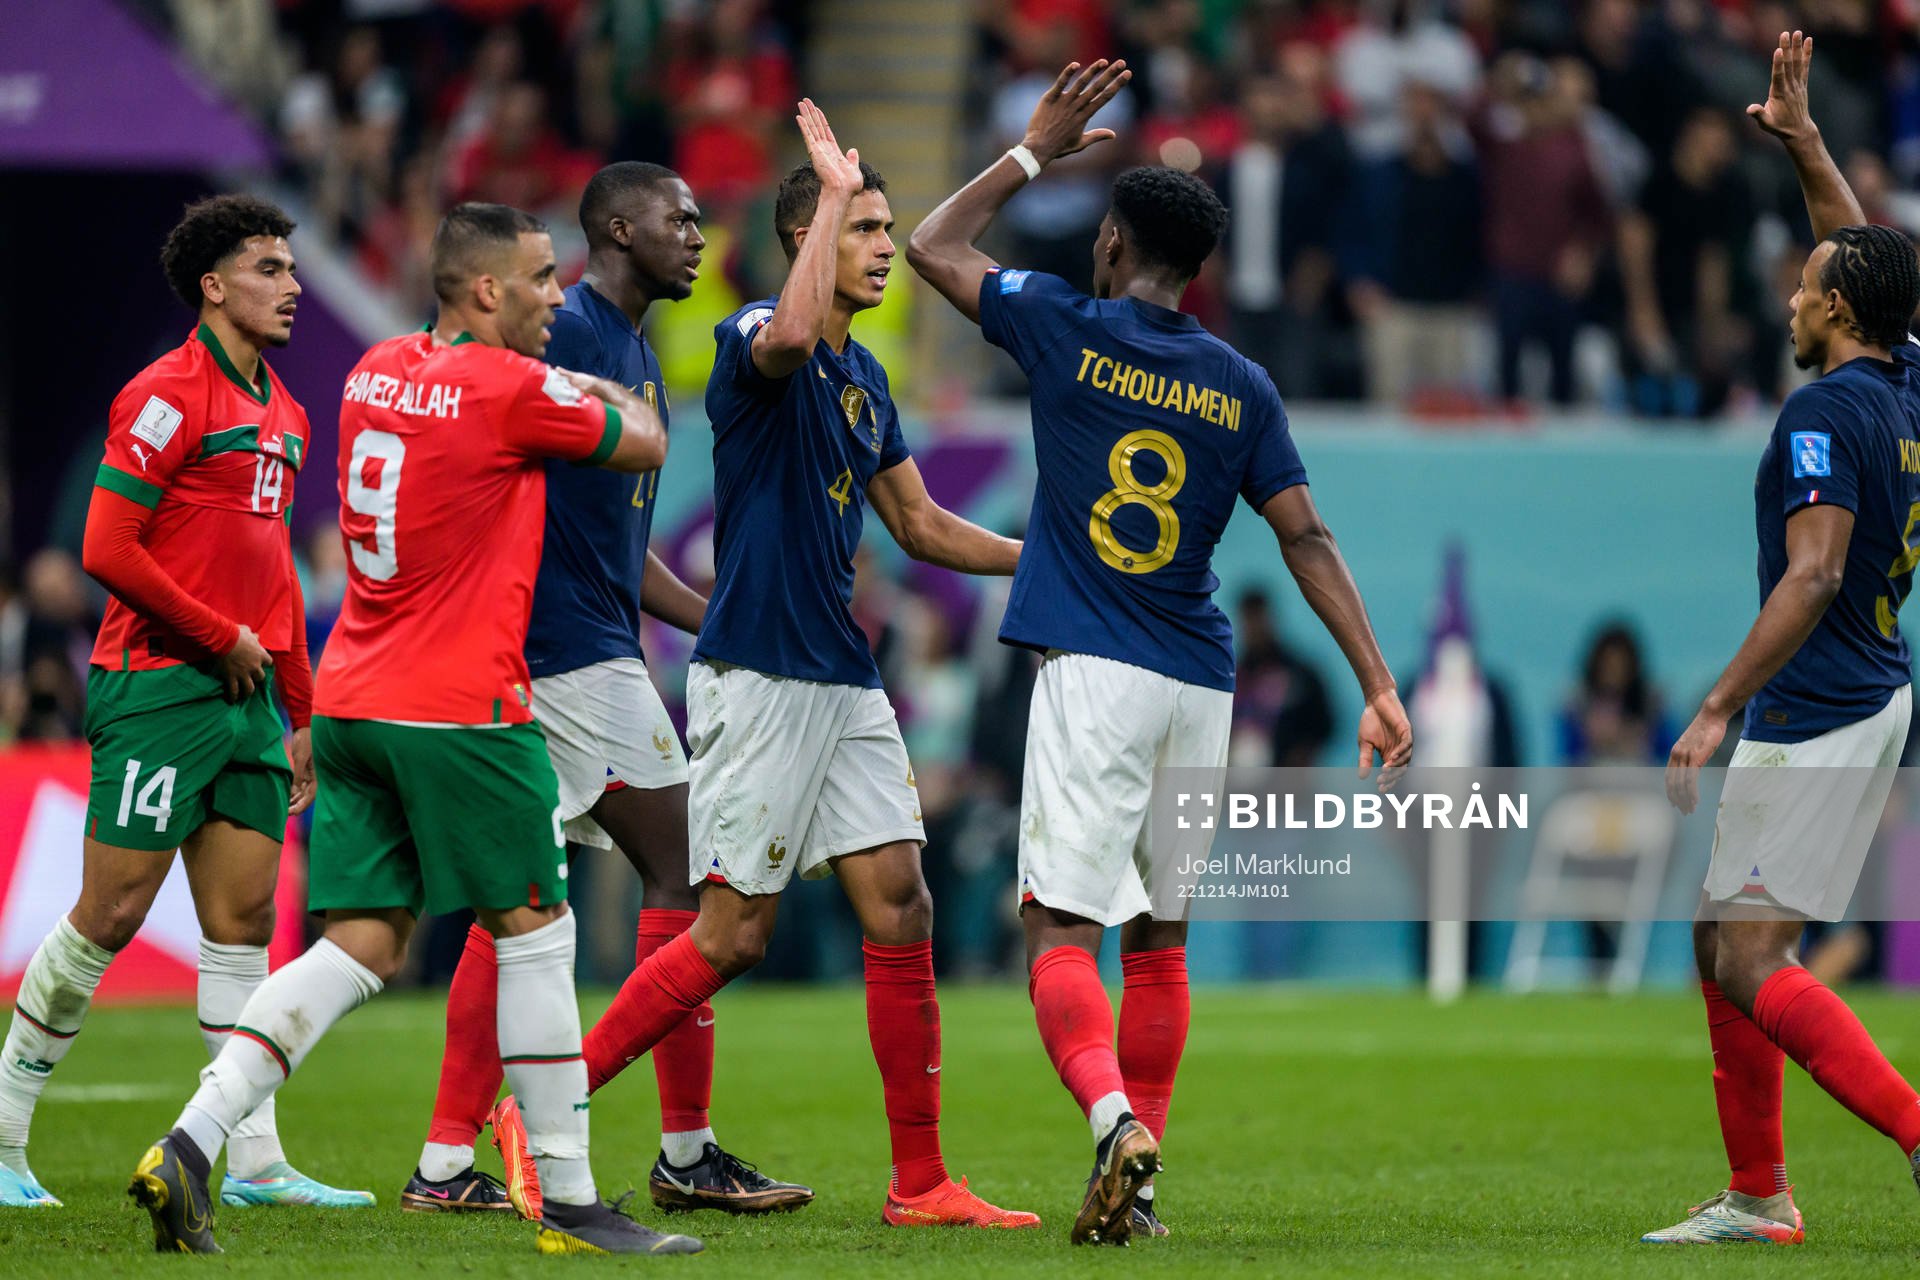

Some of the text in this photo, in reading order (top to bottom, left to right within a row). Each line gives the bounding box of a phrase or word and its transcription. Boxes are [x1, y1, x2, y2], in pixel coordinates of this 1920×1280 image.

[393, 381, 462, 419] ALLAH
[1076, 348, 1242, 432] TCHOUAMENI
[252, 442, 283, 513] 14
[347, 428, 406, 582] 9
[828, 467, 853, 517] 4
[1089, 429, 1187, 575] 8
[116, 758, 177, 833] 14
